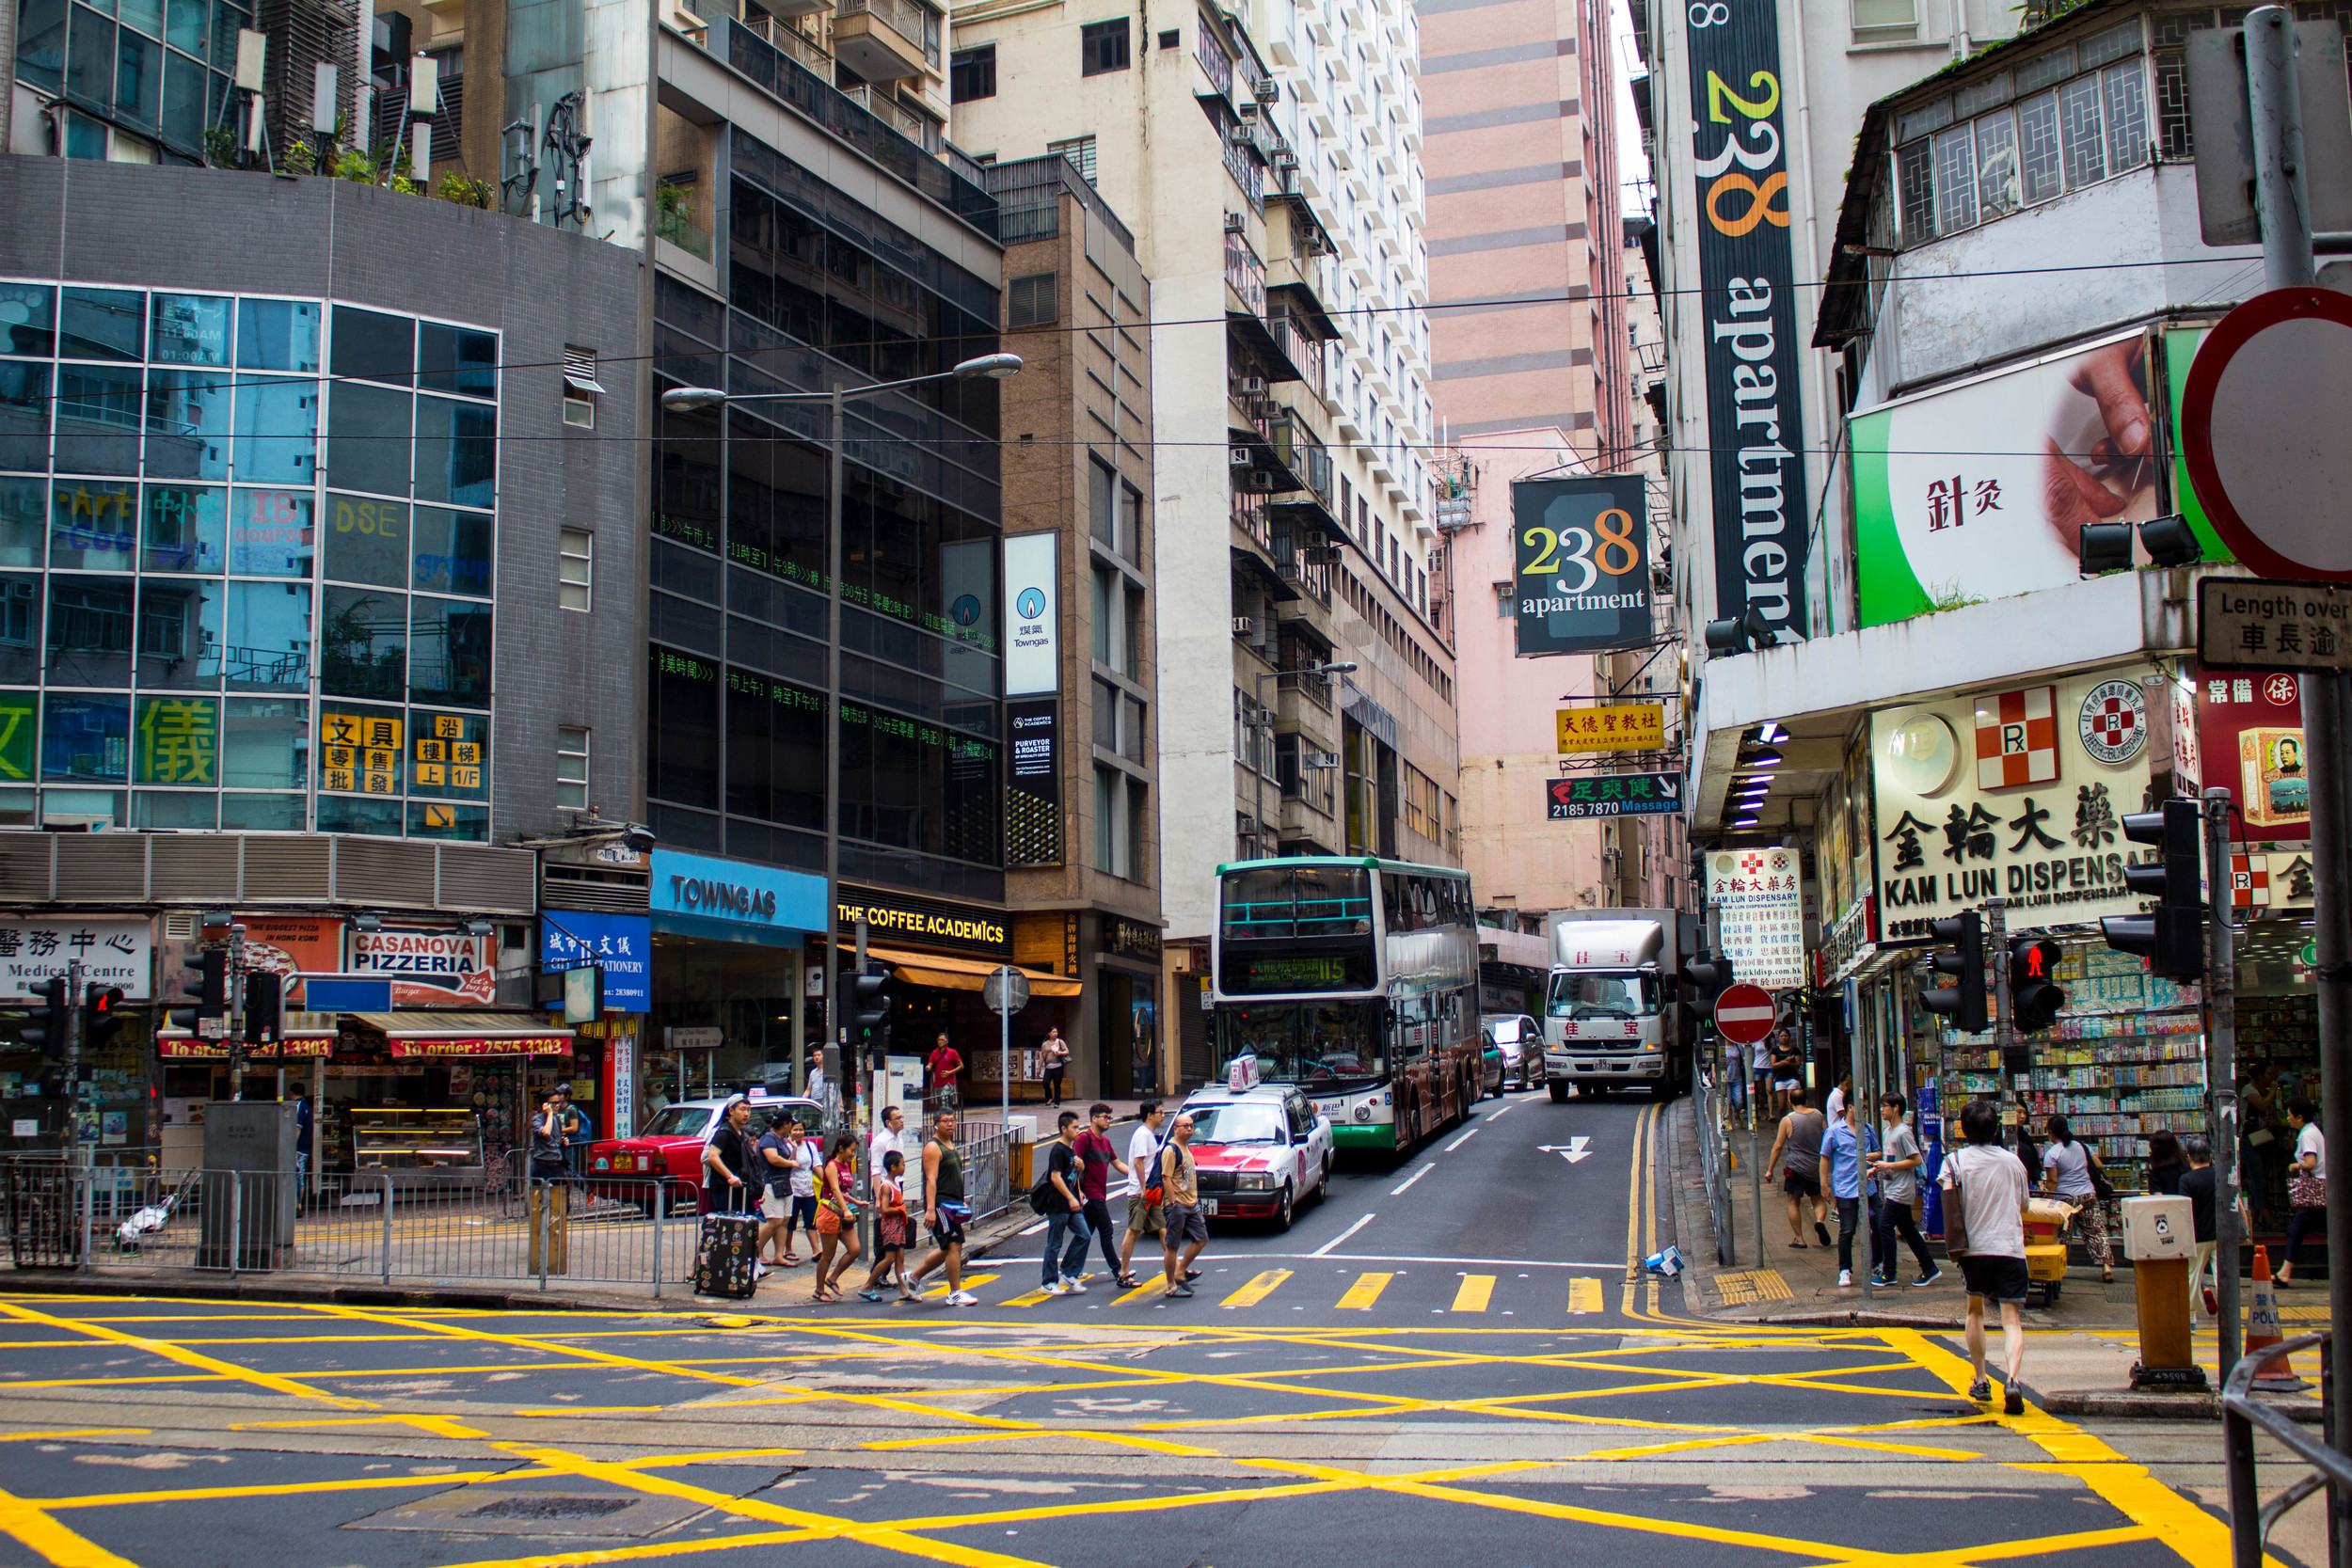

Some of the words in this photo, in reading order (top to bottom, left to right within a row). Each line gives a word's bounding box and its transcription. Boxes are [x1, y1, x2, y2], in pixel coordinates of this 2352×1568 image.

[1689, 2, 1729, 28] 8
[1692, 70, 1789, 237] 238
[251, 491, 296, 524] IB
[1927, 474, 2004, 533] 針灸
[336, 500, 399, 538] DSE
[234, 527, 310, 543] course
[1521, 508, 1640, 594] 238
[415, 553, 491, 586] group
[1521, 589, 1645, 619] apartment
[2221, 593, 2296, 619] Length
[2303, 601, 2350, 619] over
[1014, 638, 1049, 648] Towngas
[2239, 622, 2336, 657] 車長逾
[2208, 678, 2253, 705] 常備
[2266, 676, 2294, 702] 保
[330, 718, 394, 748] 文具
[440, 719, 458, 737] 沿
[1563, 712, 1658, 734] 天德聖教社
[138, 698, 215, 784] 儀
[422, 741, 475, 763] 樓梯
[1015, 738, 1050, 748] PURVEYOR
[1021, 746, 1050, 754] ROASTER
[330, 749, 389, 771] 零售
[330, 771, 389, 793] 批發
[422, 766, 439, 784] 上
[454, 769, 478, 785] 1/F
[1571, 777, 1654, 801] 足爽健
[1552, 803, 1584, 816] 2185
[1587, 801, 1619, 816] 7870
[1621, 800, 1678, 812] Massage
[1883, 782, 2153, 873] 金輪大藥
[1712, 874, 1797, 895] 金輪大藥房
[1884, 875, 1938, 909] KAM
[1947, 867, 1997, 900] LUN
[2276, 854, 2314, 900] 金
[671, 874, 776, 918] TOWNGAS
[1709, 895, 1728, 904] KAM
[1730, 895, 1746, 903] LUN
[1748, 893, 1798, 903] DISPENSARY
[2004, 896, 2025, 909] AM
[2026, 894, 2051, 907] LUN
[836, 904, 865, 922] THE
[867, 907, 925, 932] COFFEE
[1803, 911, 1818, 922] oom
[0, 927, 136, 958] 醫務中心
[355, 934, 475, 956] CASANOVA
[549, 932, 580, 953] 城市
[598, 935, 631, 957] 文儀
[1760, 945, 1802, 956] 忠誠服務
[8, 963, 70, 977] Medica
[79, 964, 135, 977] Centre
[354, 954, 474, 974] PIZZERIA
[550, 958, 572, 970] CITY
[1319, 958, 1345, 980] 115
[1733, 967, 1803, 977] un@kldisp.com.hk
[614, 988, 644, 997] 28380911
[1565, 1022, 1579, 1036] 佳
[1624, 1021, 1639, 1035] 宝
[167, 1040, 185, 1056] To
[289, 1039, 328, 1056] 3303
[401, 1040, 422, 1055] To
[484, 1039, 524, 1054] 2575
[525, 1039, 563, 1054] 3303
[1321, 1102, 1341, 1112] 新巴
